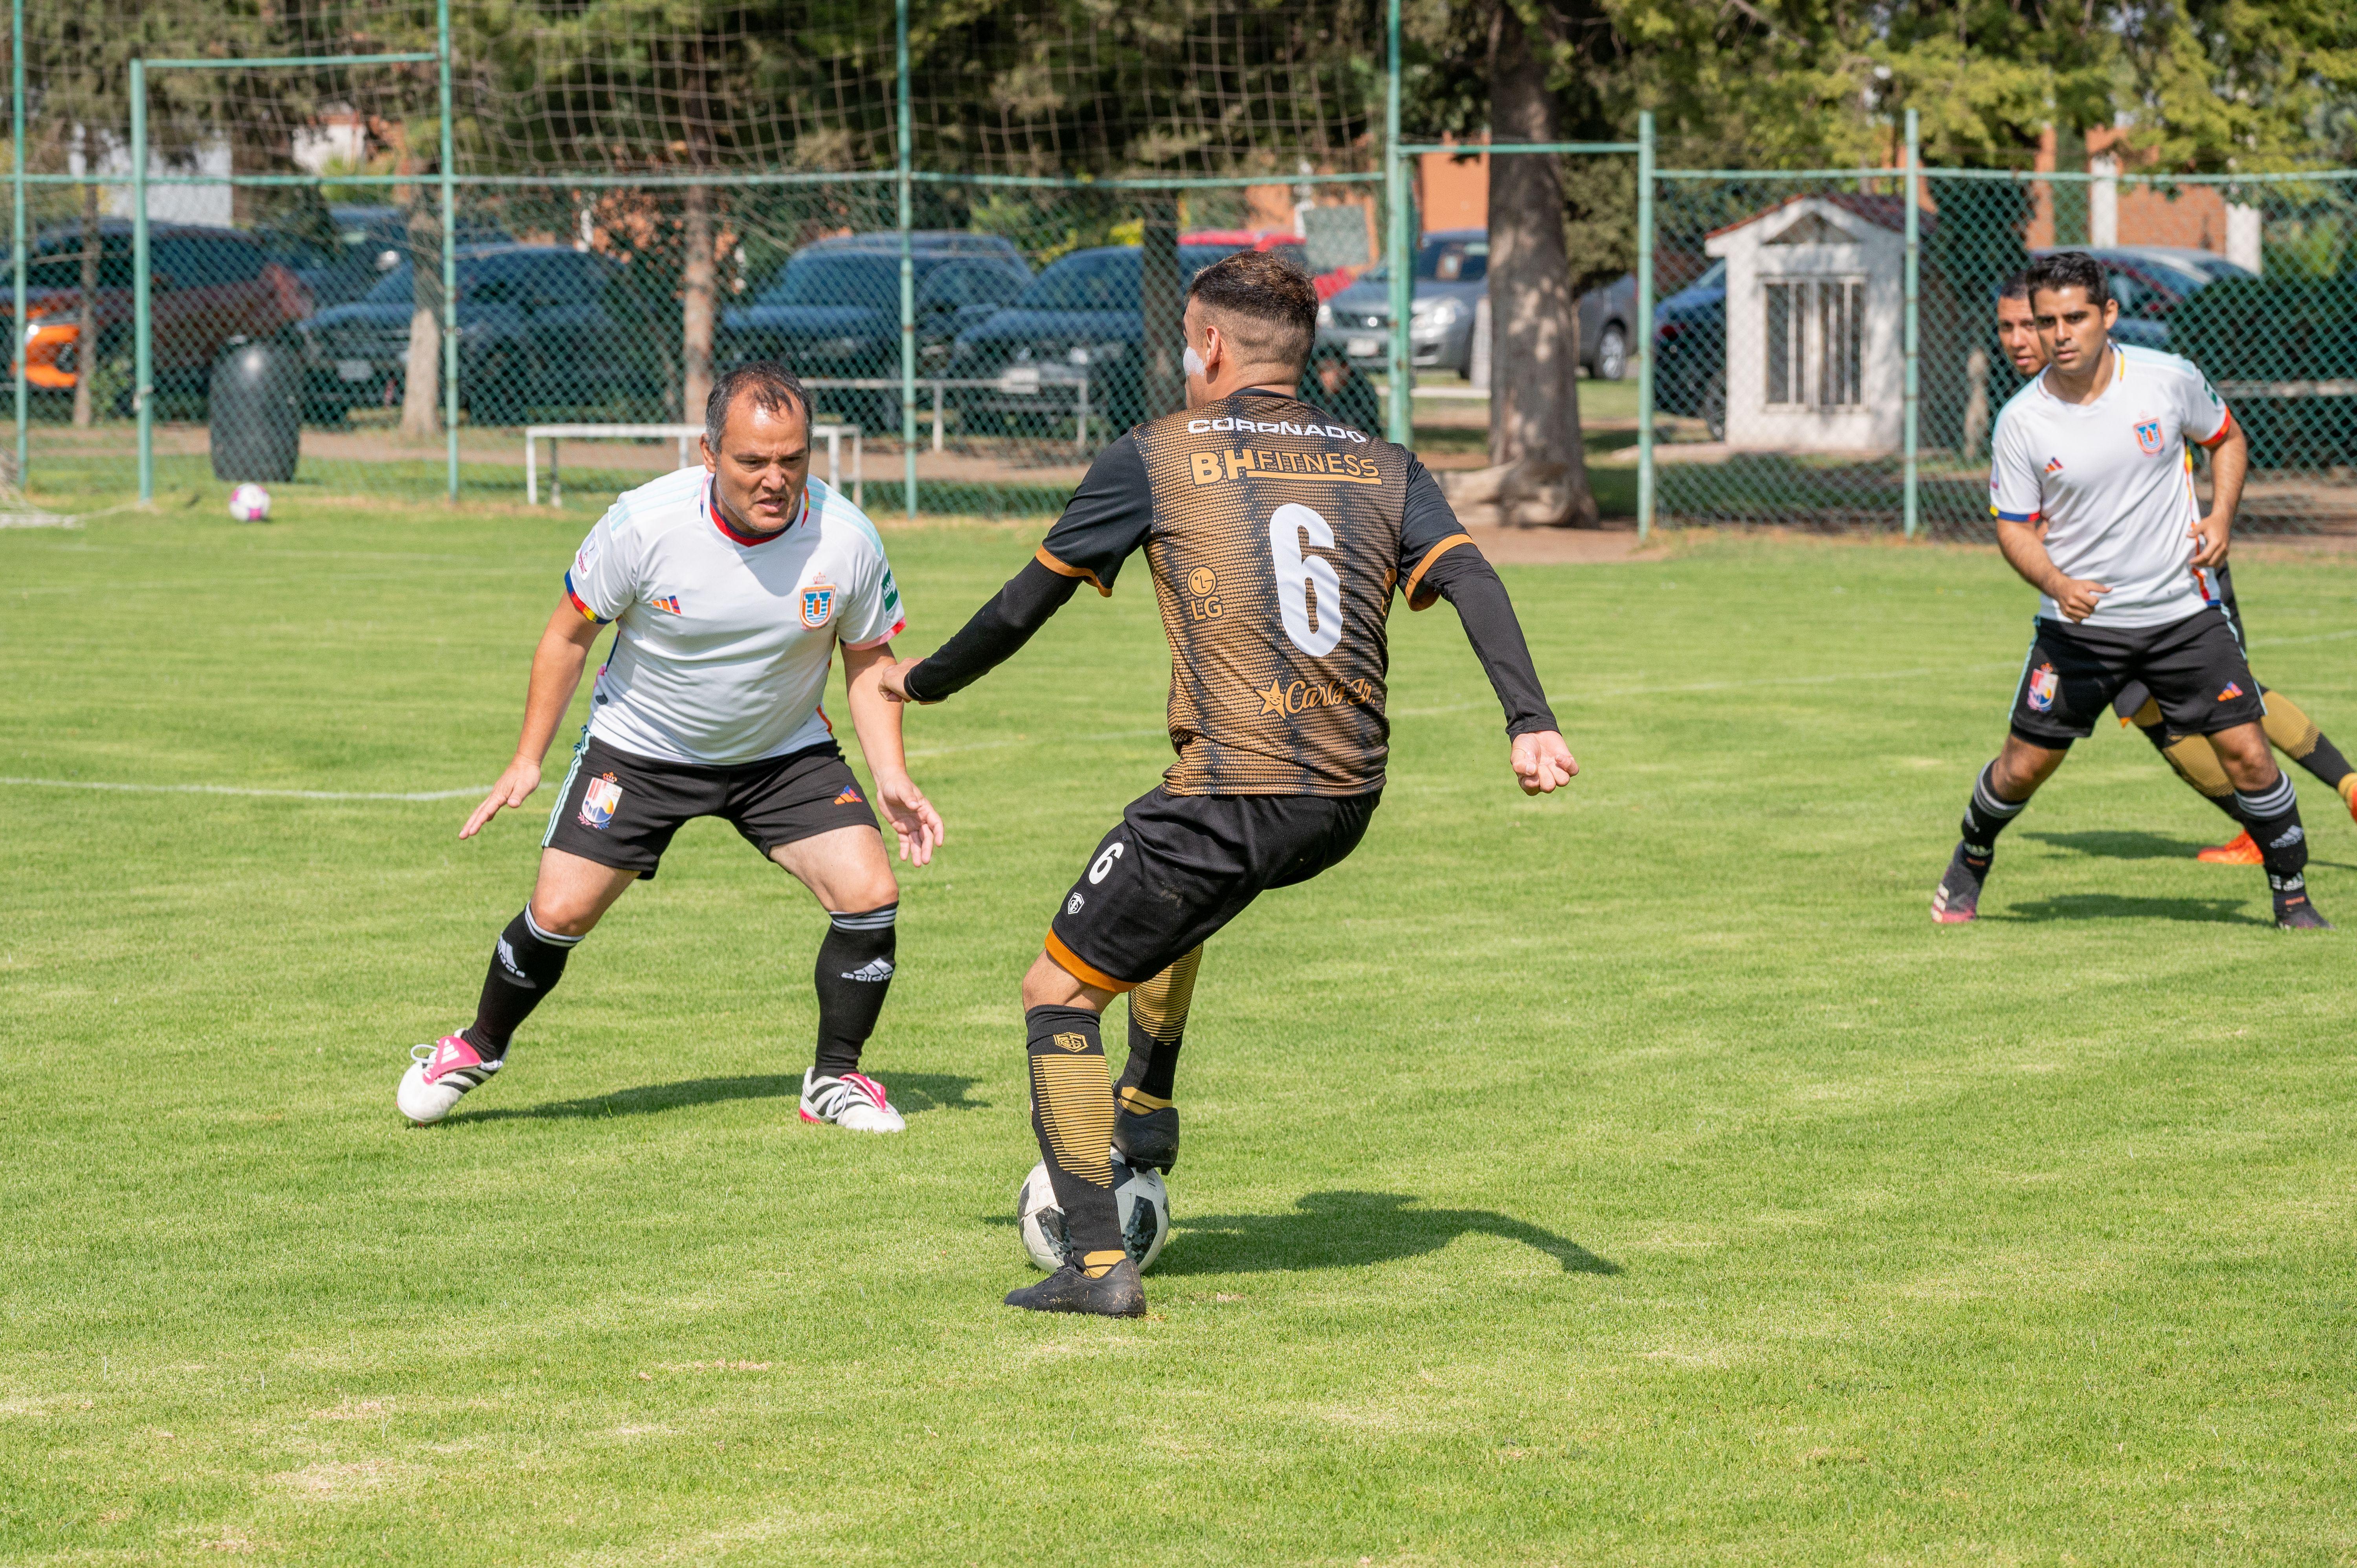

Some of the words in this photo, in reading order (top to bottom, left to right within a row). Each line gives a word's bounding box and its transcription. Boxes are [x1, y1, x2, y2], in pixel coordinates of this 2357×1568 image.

[1188, 417, 1366, 443] CORONADO
[1269, 503, 1344, 657] 6
[1190, 596, 1223, 621] LG
[1285, 677, 1346, 713] Carl's
[1089, 842, 1124, 885] 6
[841, 972, 894, 982] adida
